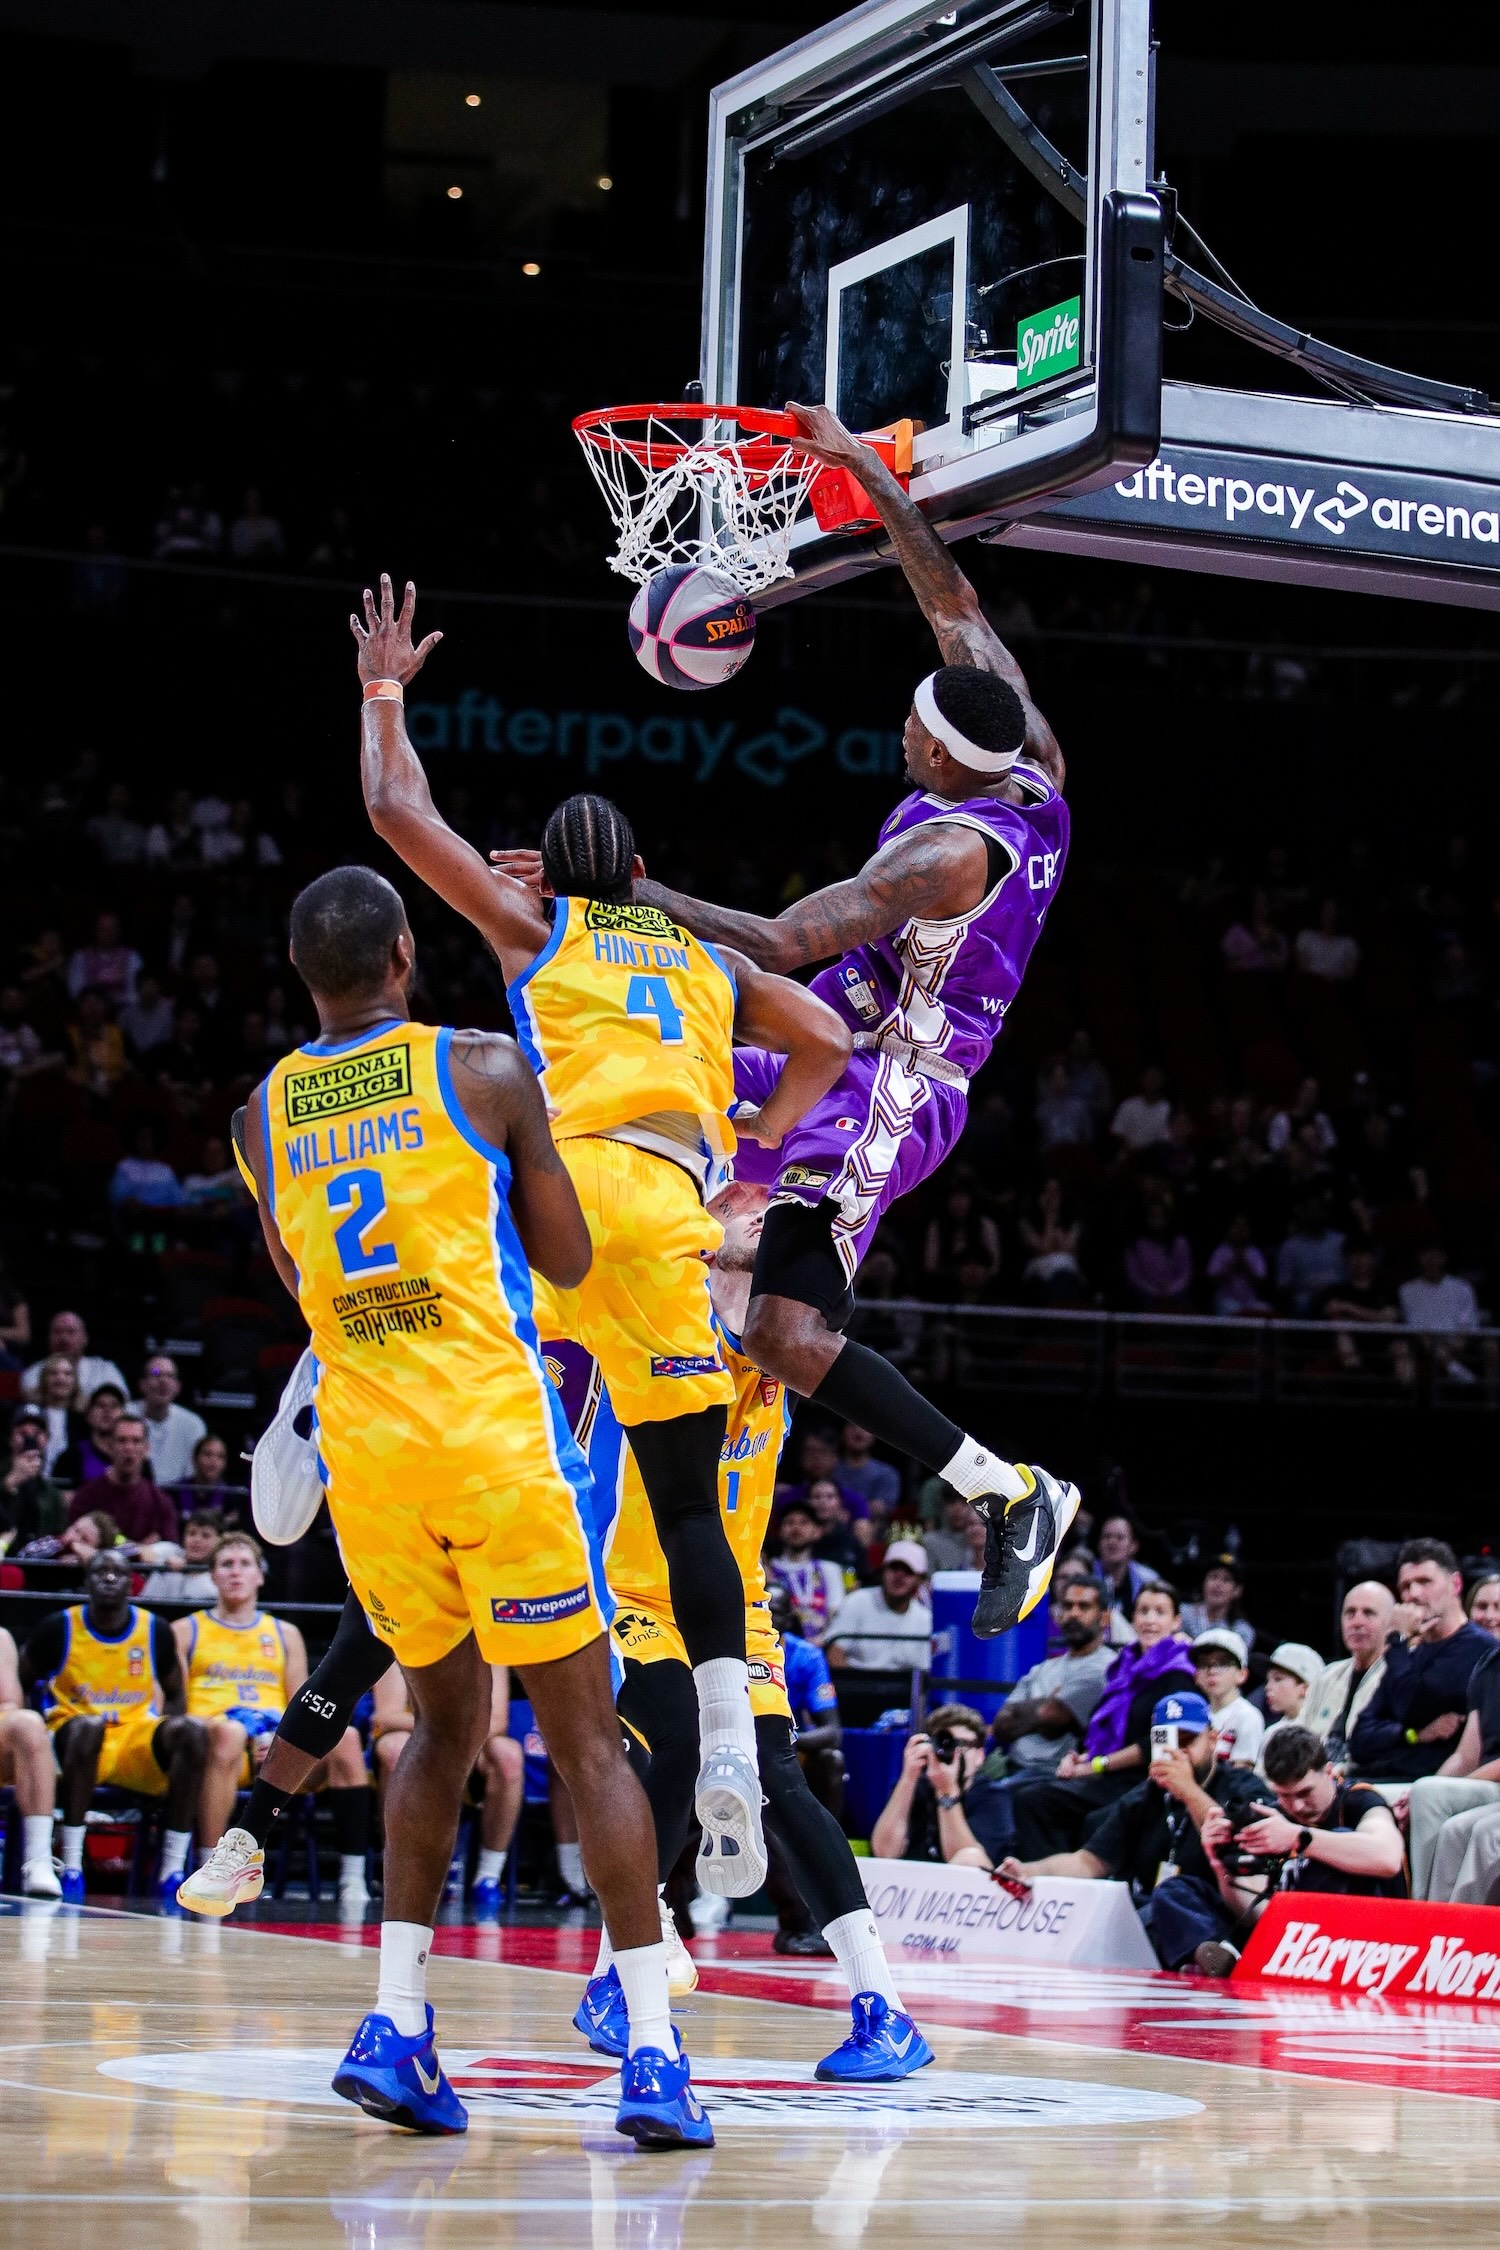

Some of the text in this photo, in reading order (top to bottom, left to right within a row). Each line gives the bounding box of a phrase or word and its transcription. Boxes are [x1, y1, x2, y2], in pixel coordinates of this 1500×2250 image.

[1018, 313, 1079, 376] Sprite
[1114, 458, 1500, 543] afterpay arena
[406, 689, 736, 782] afterpay
[593, 932, 691, 972] HINTON
[626, 974, 686, 1046] 4
[292, 1052, 401, 1094] NATIONAL
[296, 1072, 398, 1114] STORAGE
[285, 1108, 424, 1178] WILLIAMS
[784, 1171, 801, 1184] NBL
[326, 1167, 400, 1282] 2
[332, 1277, 431, 1314] CONSTRUCTION
[343, 1303, 442, 1347] PATHWAYS
[520, 1589, 587, 1616] Tyrepower
[748, 1664, 768, 1678] NBL
[300, 1689, 337, 1720] 1:50
[914, 1889, 1075, 1934] WAREHOUSE
[1261, 1920, 1420, 1996] Harvey
[508, 2102, 1041, 2113] MTORS
